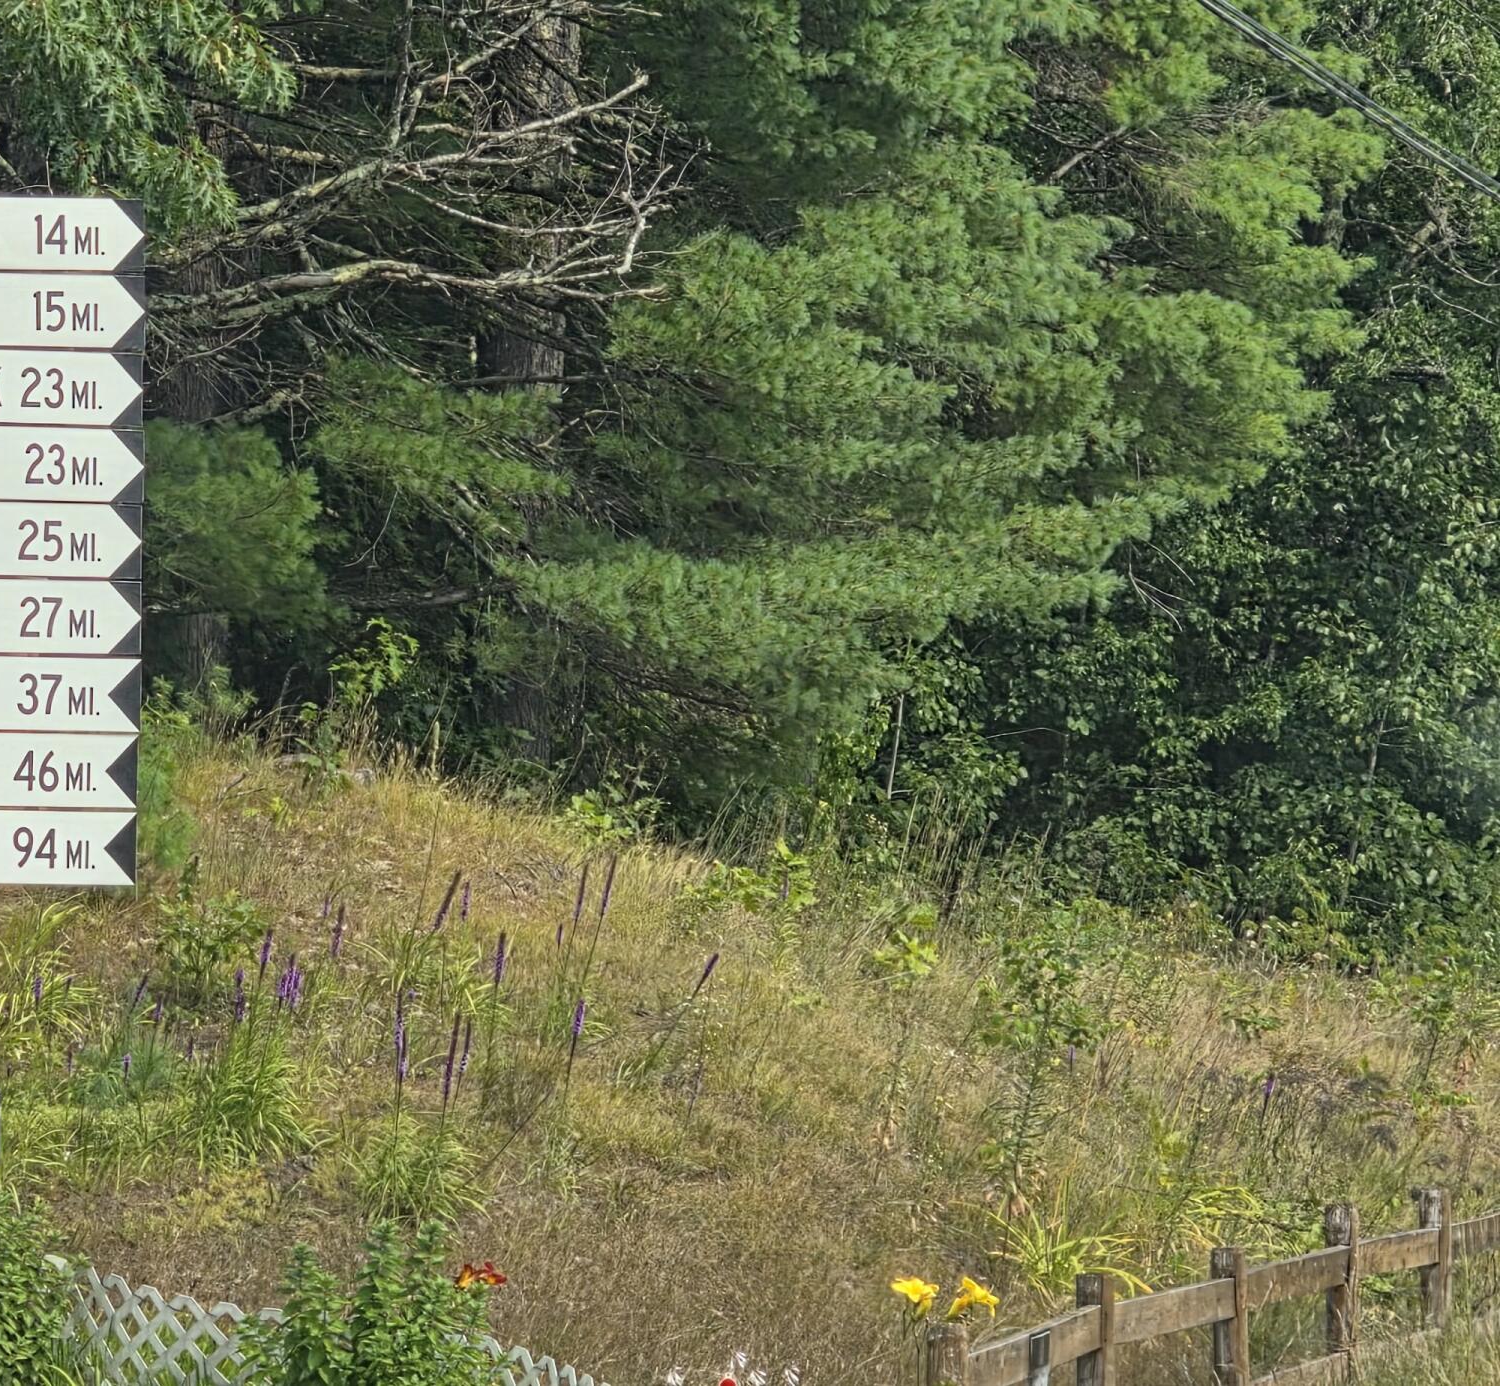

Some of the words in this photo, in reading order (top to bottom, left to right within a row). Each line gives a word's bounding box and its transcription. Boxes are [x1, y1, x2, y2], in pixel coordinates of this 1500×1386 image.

[35, 215, 67, 254] 14
[75, 227, 105, 255] MI.
[33, 291, 65, 331] 15
[72, 303, 104, 331] MI.
[21, 367, 64, 408] 23
[72, 381, 102, 409] MI.
[25, 443, 65, 485] 23
[72, 457, 102, 486] MI.
[18, 520, 62, 561] 25
[71, 533, 101, 561] MI.
[20, 597, 62, 637] 27
[70, 610, 100, 638] MI.
[17, 674, 62, 714] 37
[69, 687, 99, 715] MI.
[13, 751, 59, 792] 46
[66, 763, 96, 791] MI.
[13, 827, 57, 868] 94
[67, 840, 95, 869] MI.
